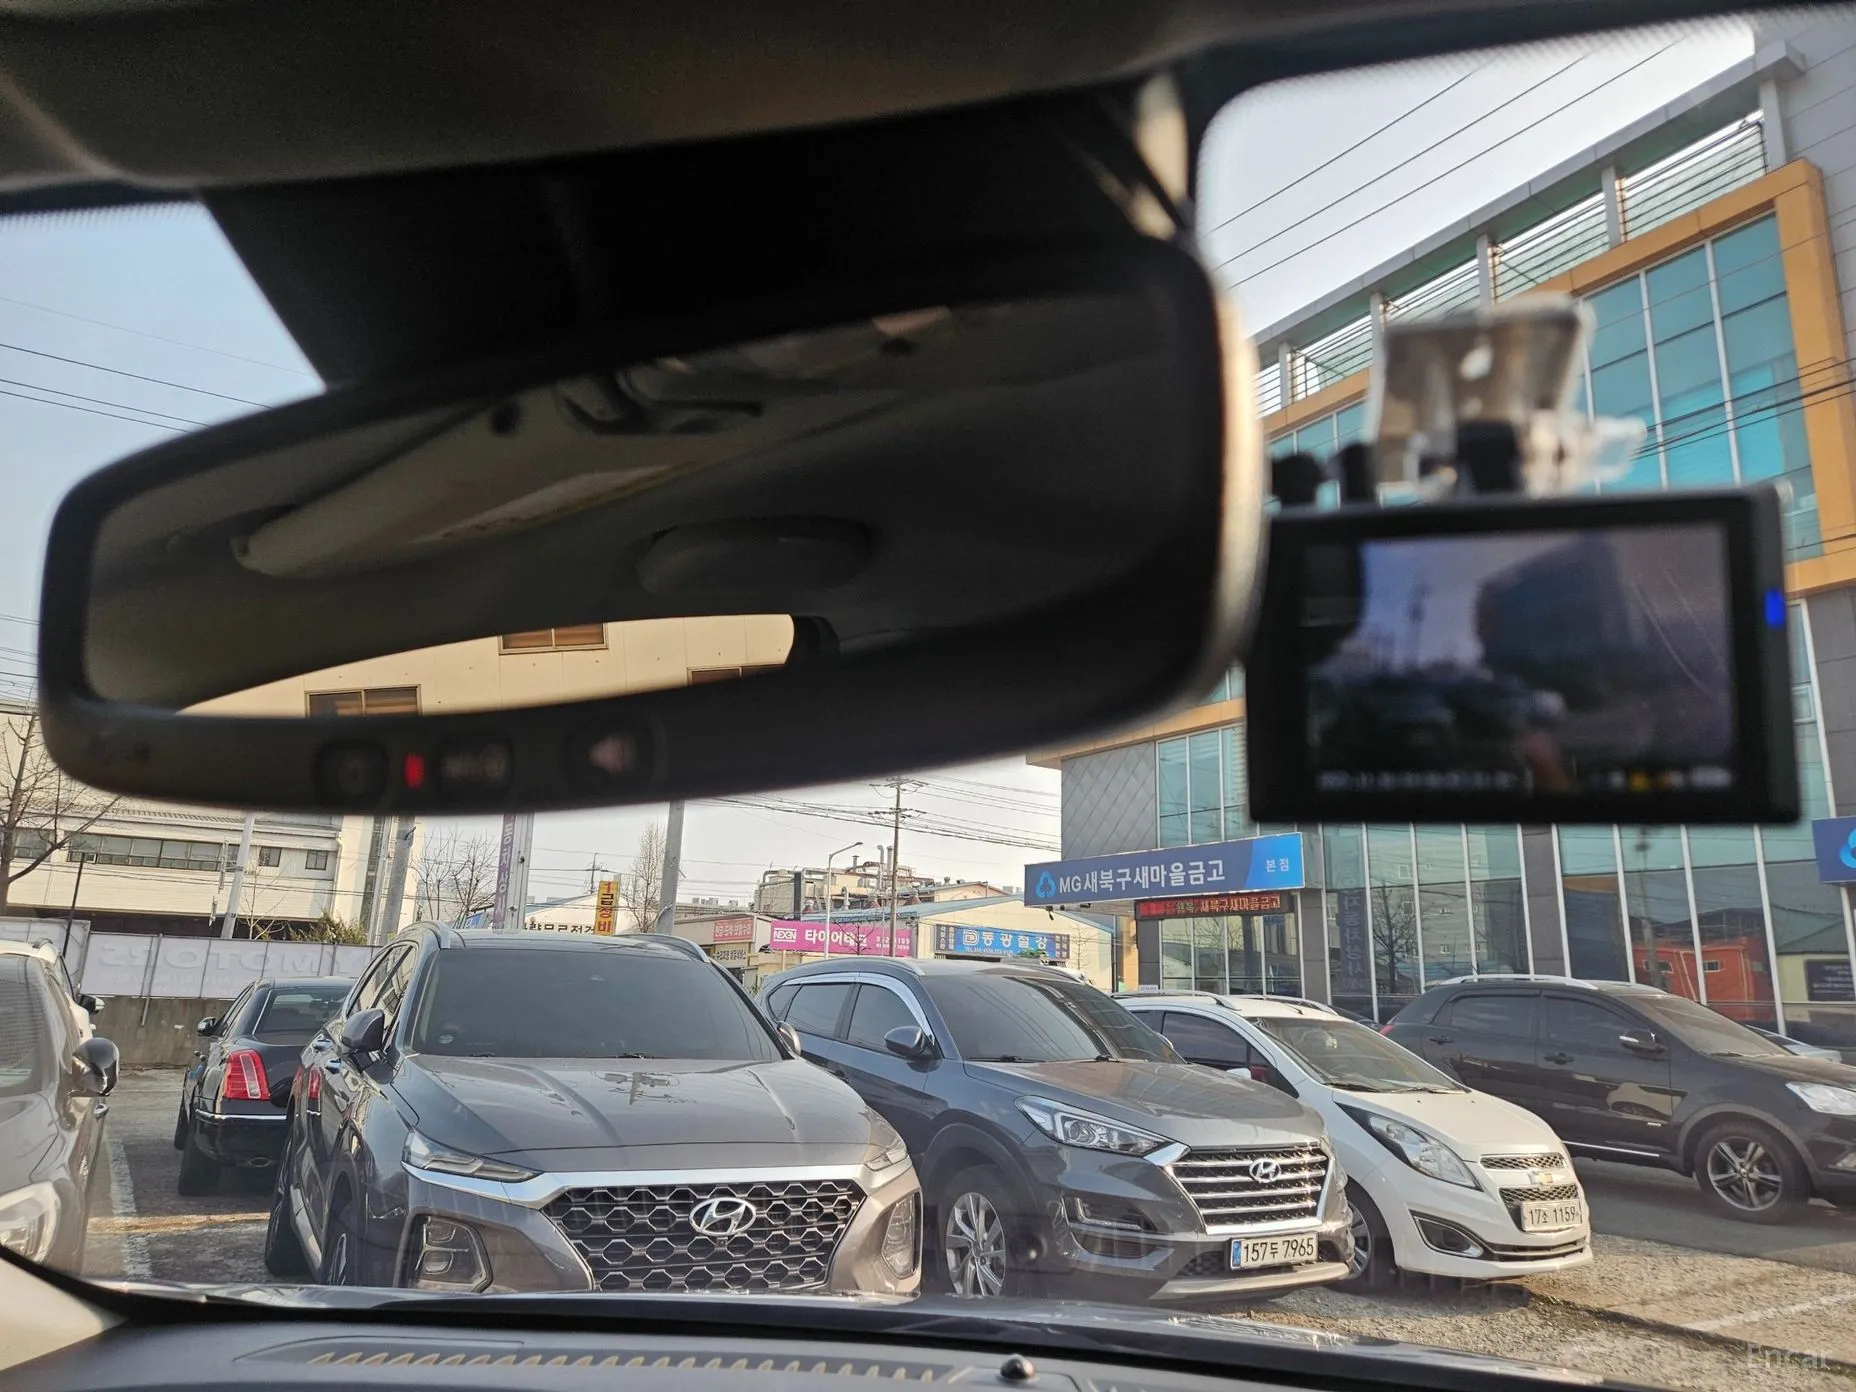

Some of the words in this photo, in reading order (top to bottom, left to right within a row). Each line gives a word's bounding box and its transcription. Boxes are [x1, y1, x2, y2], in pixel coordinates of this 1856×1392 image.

[1265, 858, 1290, 873] 본점
[1553, 1206, 1575, 1223] 1159
[1243, 1241, 1279, 1262] 157두
[1283, 1237, 1314, 1258] 7965
